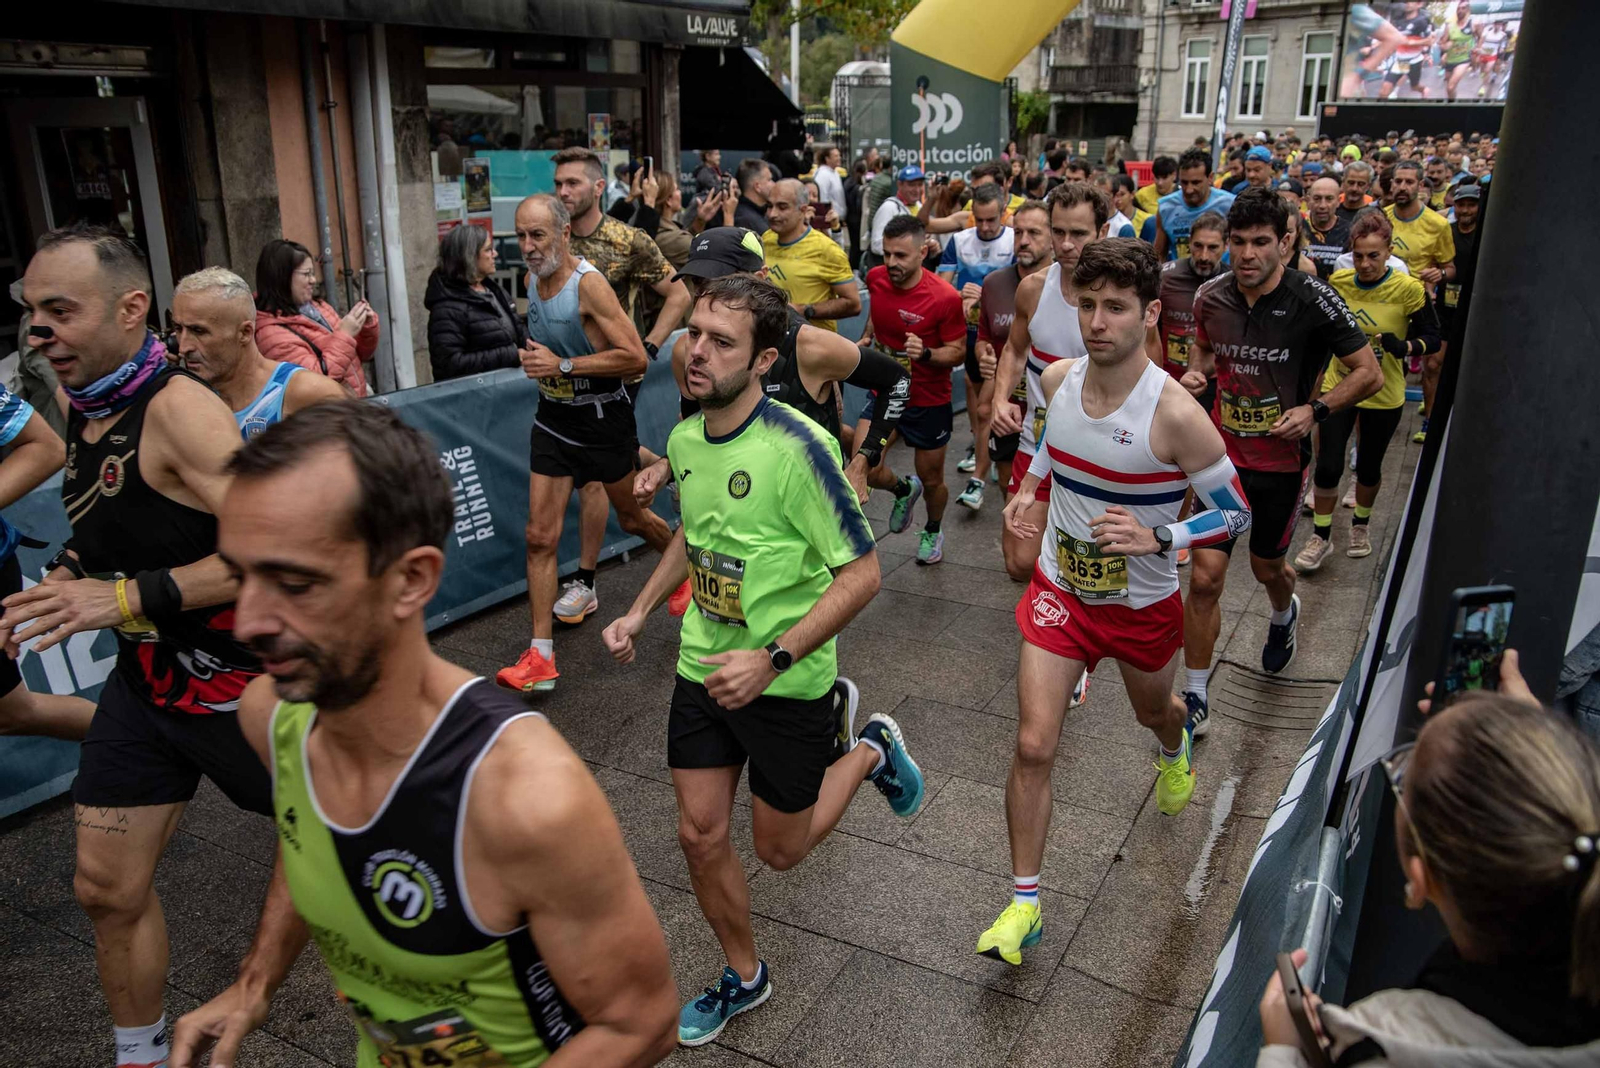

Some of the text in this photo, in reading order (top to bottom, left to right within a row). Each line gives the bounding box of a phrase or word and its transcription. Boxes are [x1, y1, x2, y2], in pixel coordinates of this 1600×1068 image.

[892, 142, 993, 166] Deputación
[1303, 275, 1356, 328] PONTESECA
[1315, 295, 1338, 321] TRAIL
[1229, 363, 1260, 376] TRAIL
[1231, 409, 1264, 423] 495
[439, 449, 476, 547] TRAIL &
[453, 445, 495, 541] RUNNING
[1067, 554, 1103, 580] 363
[1108, 560, 1123, 570] 10K
[695, 570, 719, 598] 110
[726, 584, 739, 595] 10K
[1073, 575, 1097, 588] MATEO
